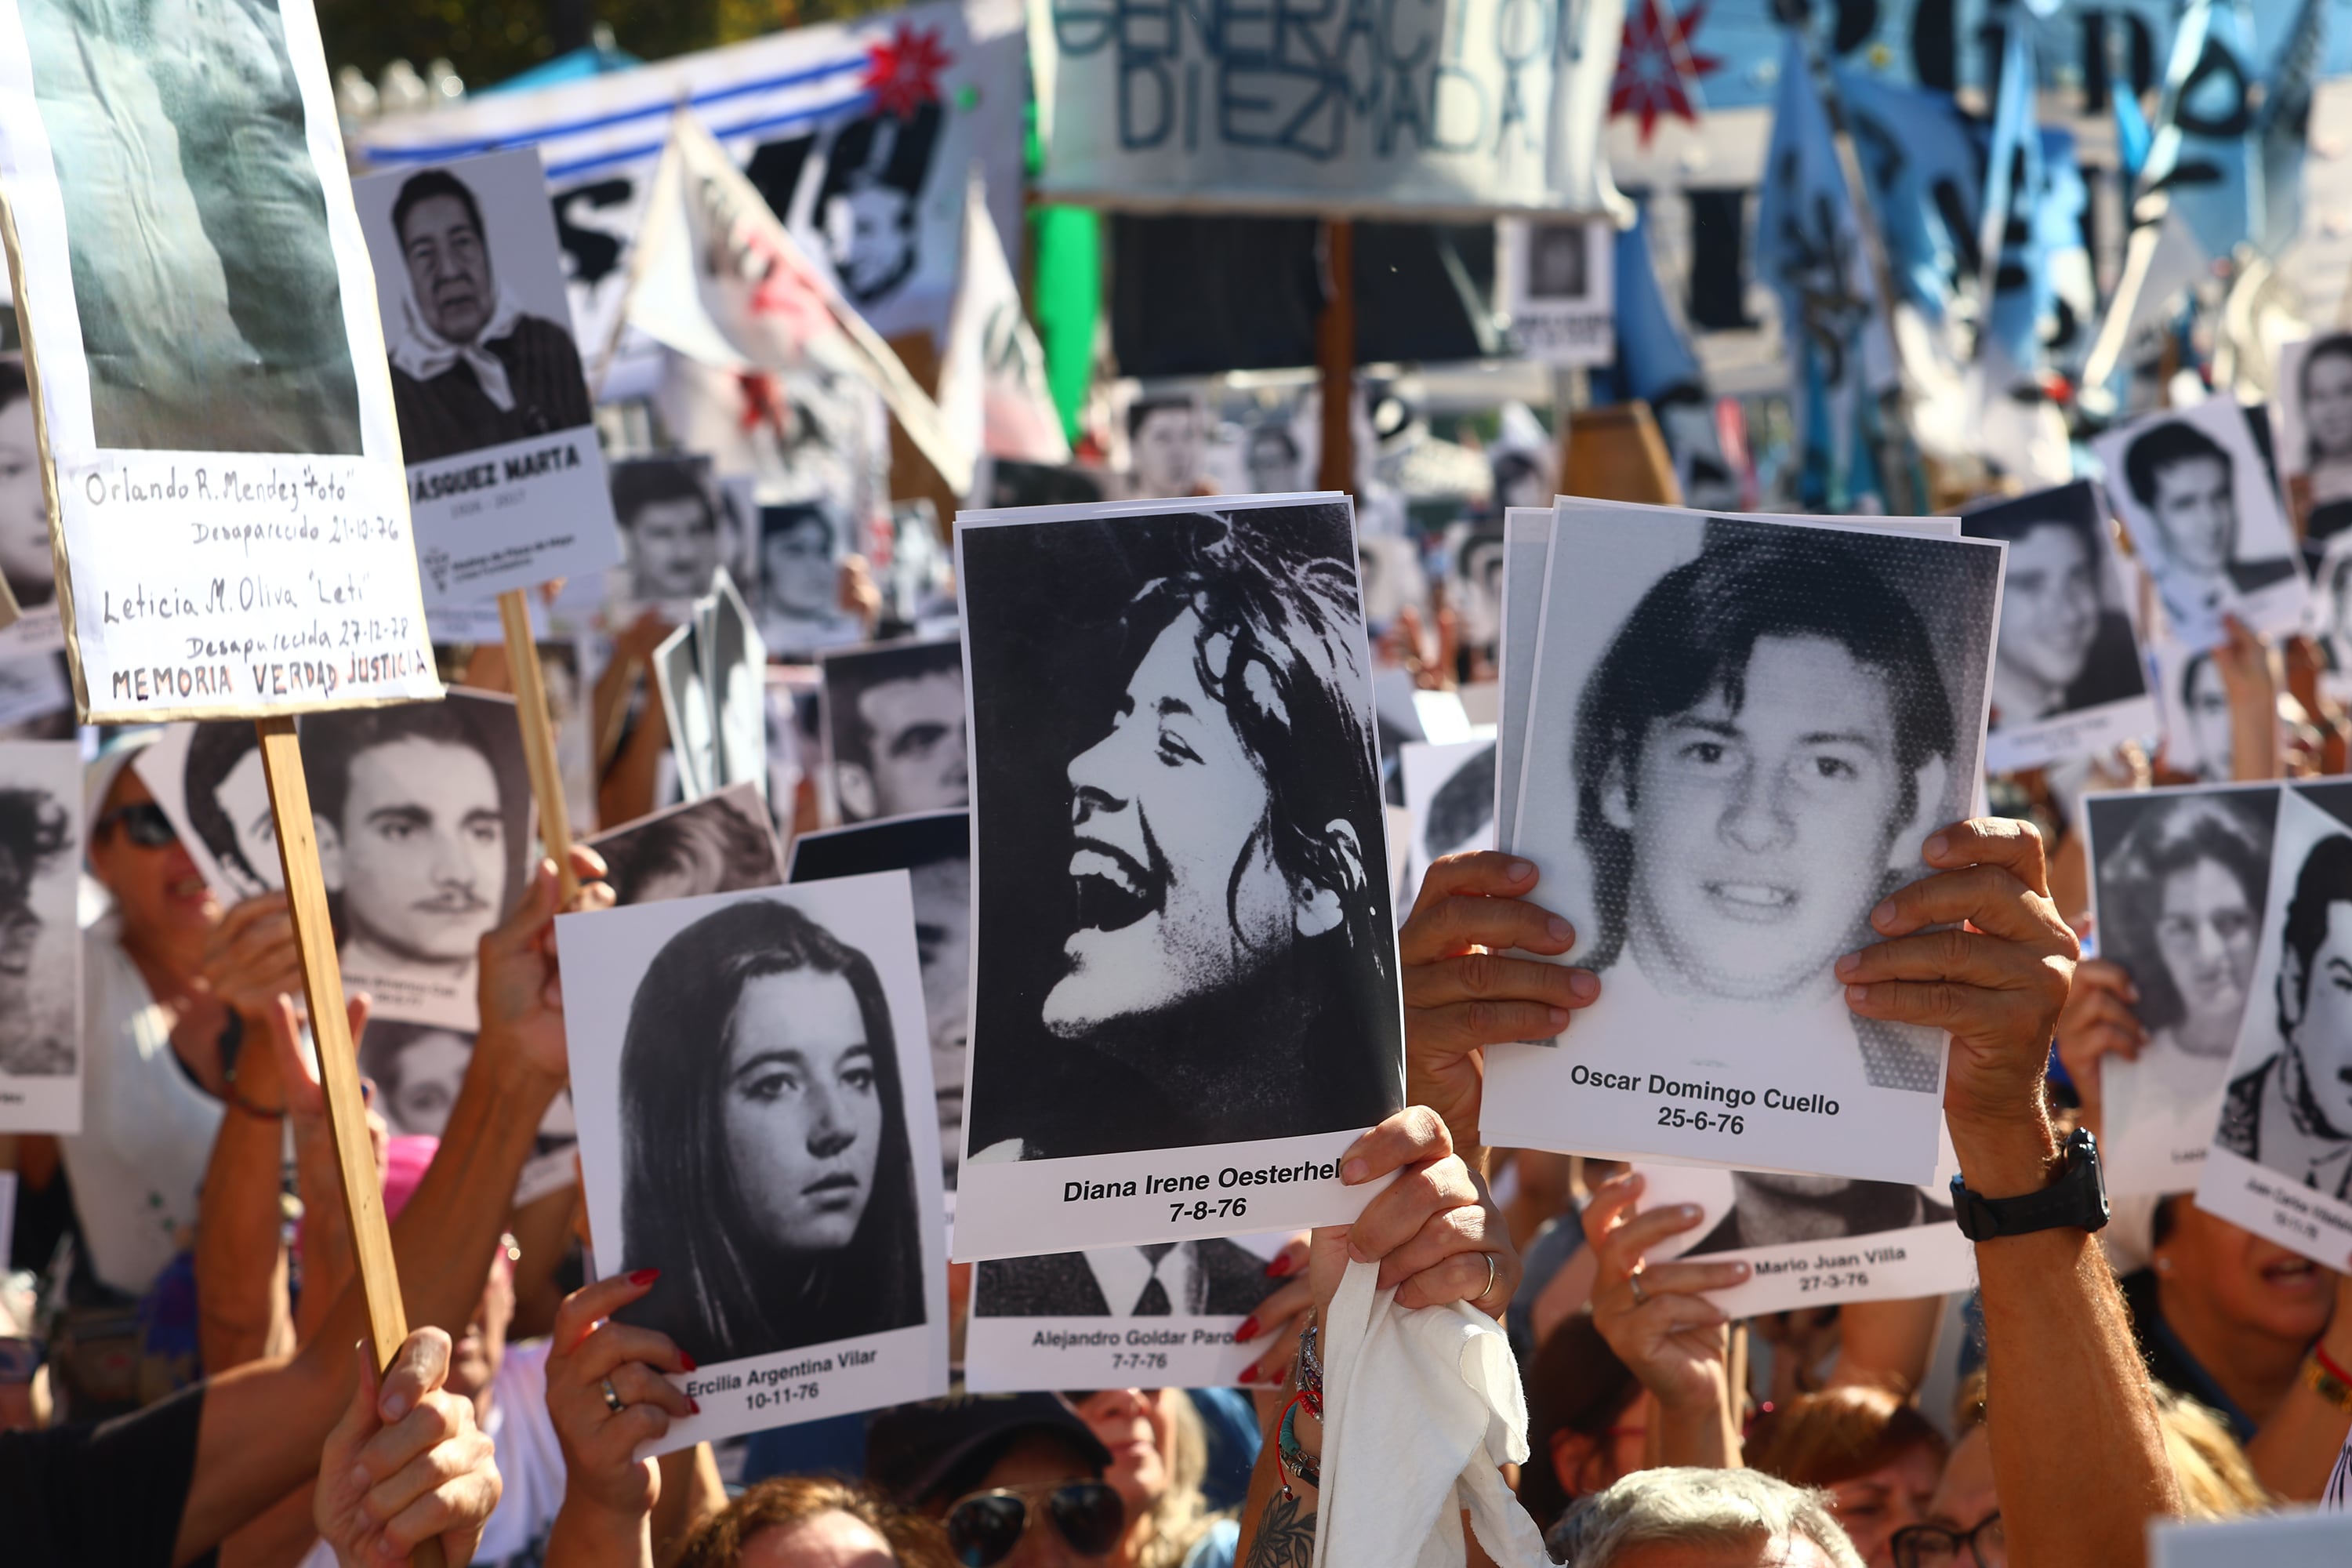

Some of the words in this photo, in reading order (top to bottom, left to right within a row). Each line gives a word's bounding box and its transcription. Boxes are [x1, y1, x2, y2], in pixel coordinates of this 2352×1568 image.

[1119, 58, 1541, 162] DIEZMADA
[85, 466, 189, 506] Orlando
[194, 468, 219, 501] R.
[223, 468, 299, 512] Mendez
[408, 461, 496, 502] ÁSQUEZ
[504, 444, 579, 480] MARTA
[191, 514, 319, 557] Desaparecido
[103, 583, 198, 624] Leticia
[205, 577, 234, 613] M.
[239, 574, 298, 612] Oliva
[112, 666, 233, 702] MEMORIA
[252, 660, 338, 699] VERDAD
[347, 649, 428, 684] JUSTICIA
[1570, 1065, 1642, 1091] Oscar
[1648, 1074, 1756, 1109] Domingo
[1763, 1088, 1839, 1116] Cuello
[1657, 1106, 1744, 1135] 25-6-76
[1063, 1180, 1137, 1203] Diana
[1145, 1174, 1210, 1195] Irene
[1169, 1197, 1247, 1222] 7-8-76
[1755, 1258, 1808, 1275] Mario
[1813, 1254, 1860, 1270] Juan
[1864, 1247, 1907, 1264] Villa
[1799, 1272, 1869, 1291] 27-3-76
[1032, 1330, 1120, 1351] Alejandro
[1126, 1329, 1187, 1346] Goldar
[686, 1375, 742, 1398] Ercilia
[747, 1359, 833, 1386] Argentina
[837, 1349, 877, 1369] Vilar
[1112, 1353, 1167, 1370] 7-7-76
[746, 1382, 820, 1410] 10-11-76
